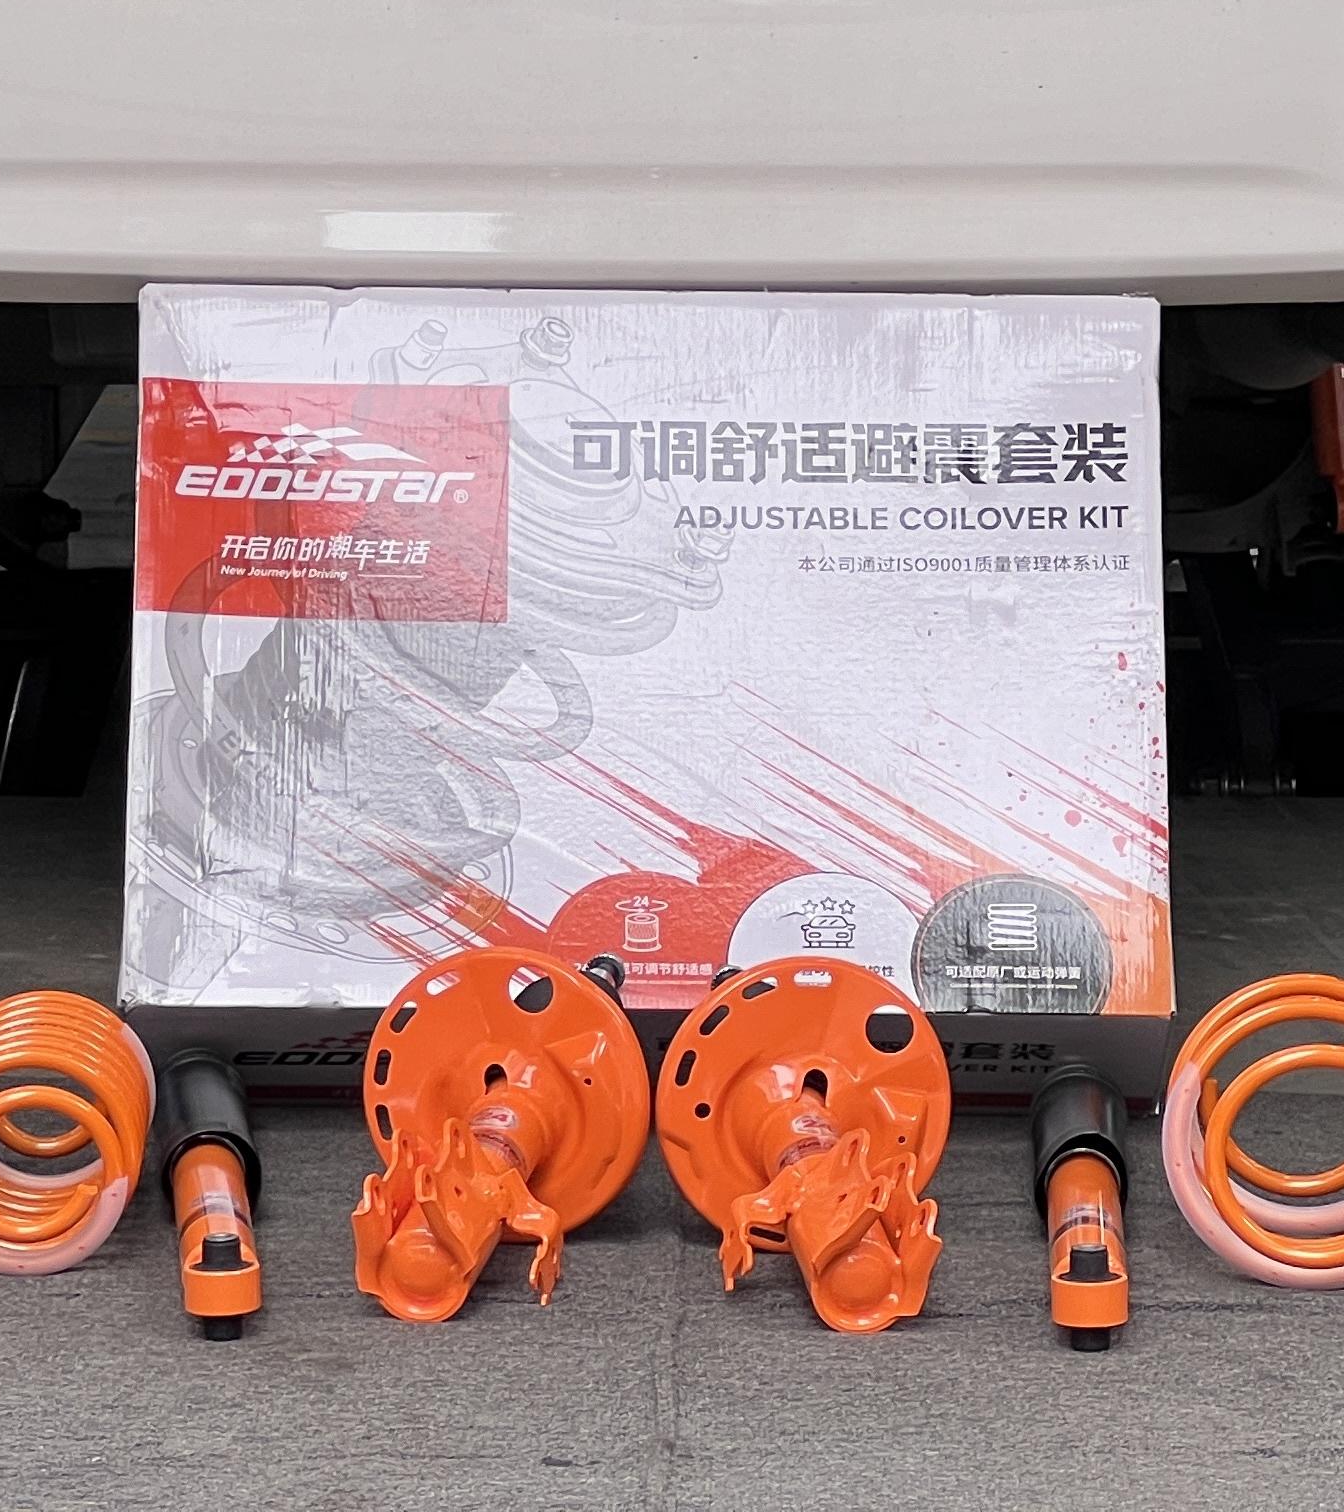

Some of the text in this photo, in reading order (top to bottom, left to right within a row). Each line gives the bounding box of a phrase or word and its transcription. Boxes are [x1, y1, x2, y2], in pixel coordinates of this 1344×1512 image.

[570, 421, 1128, 484] 可调舒适避震套装
[673, 505, 1129, 530] ADJUSTABLE COILOVER KIT
[221, 531, 432, 570] 开启你的潮车生活
[221, 565, 348, 581] New Journey of Driving
[798, 554, 1130, 574] 本公司通过ISO9001质量管理体系认证
[633, 895, 649, 907] 24
